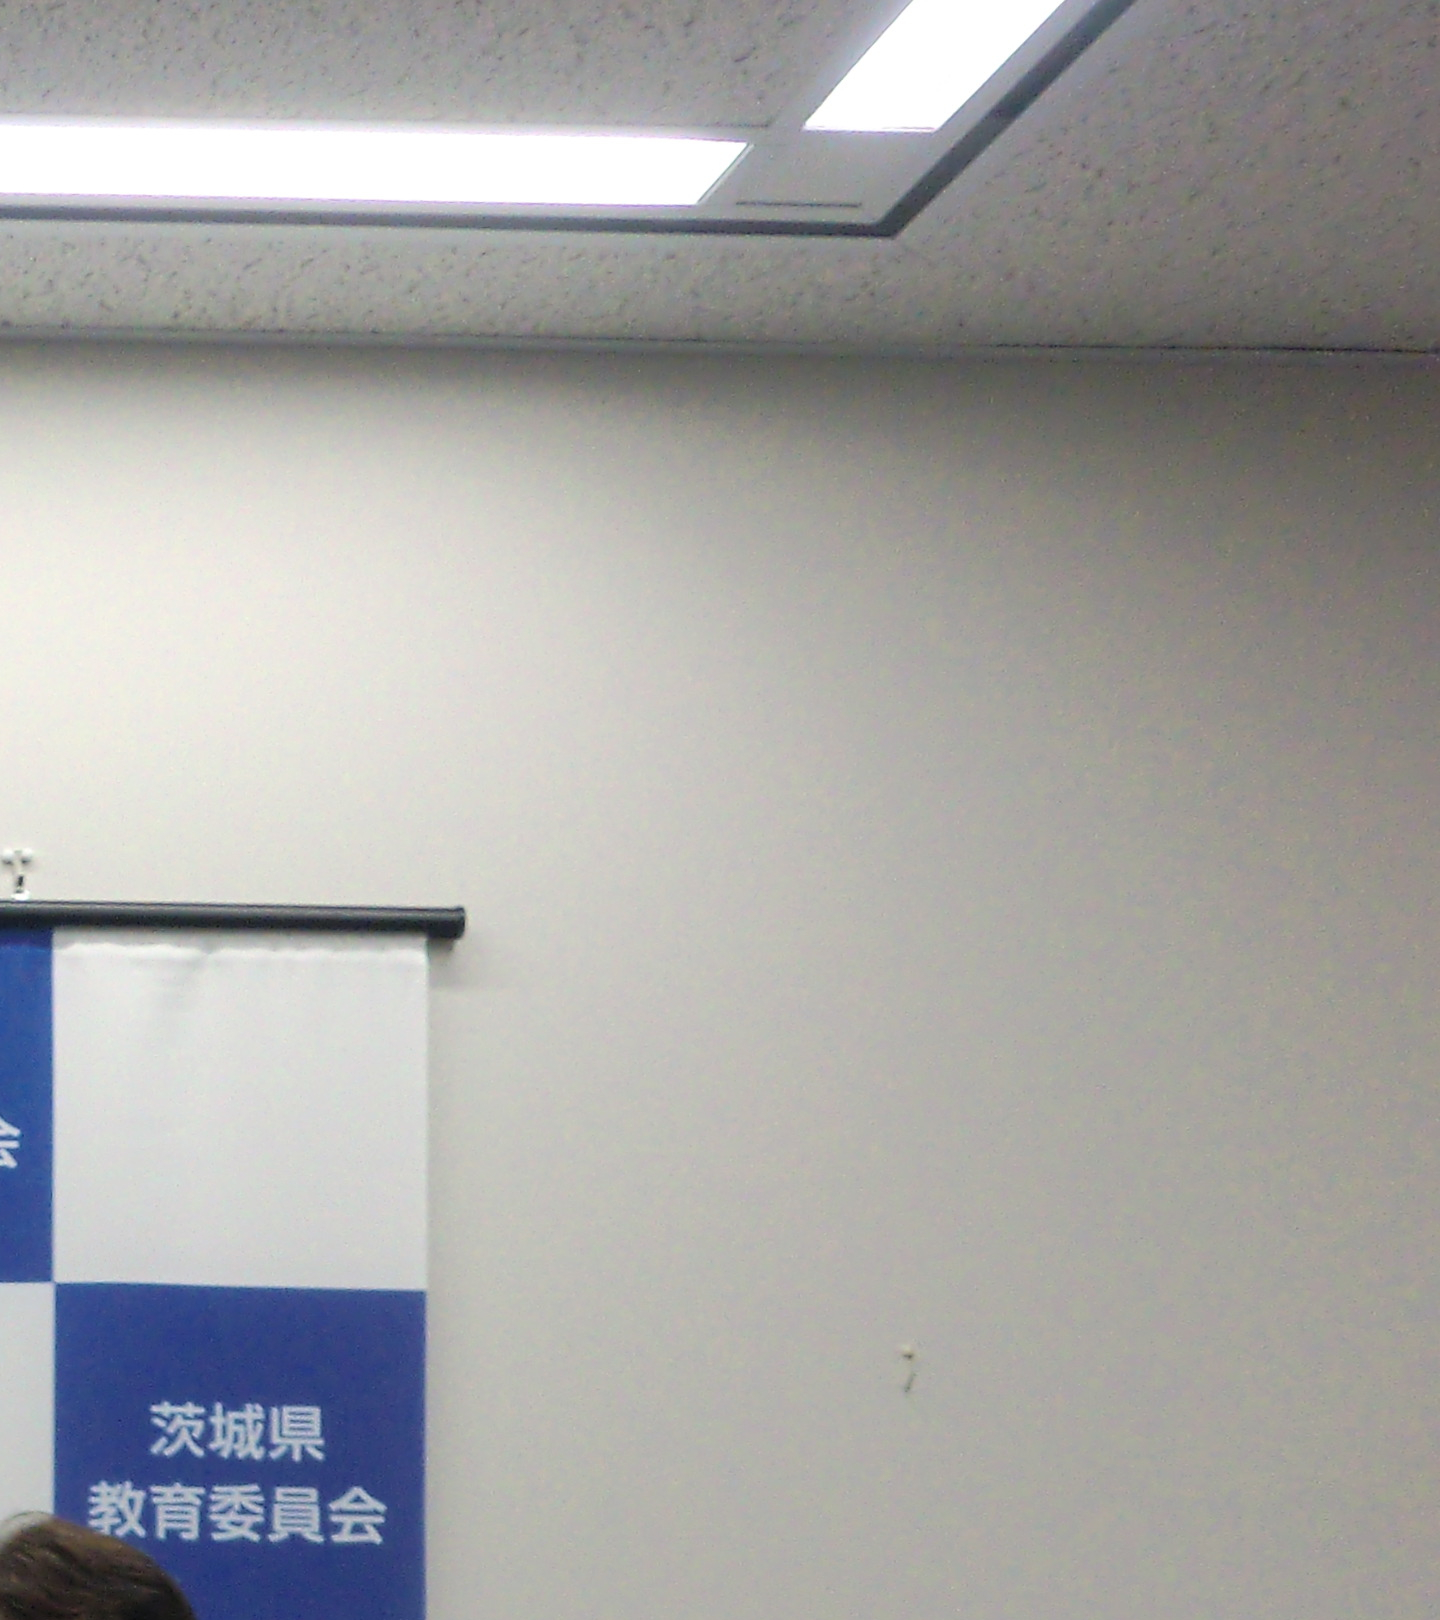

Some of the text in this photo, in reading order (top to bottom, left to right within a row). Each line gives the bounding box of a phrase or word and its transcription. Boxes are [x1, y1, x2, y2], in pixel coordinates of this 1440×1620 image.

[150, 1401, 325, 1462] 茨城県
[88, 1480, 387, 1545] 教育委員会
